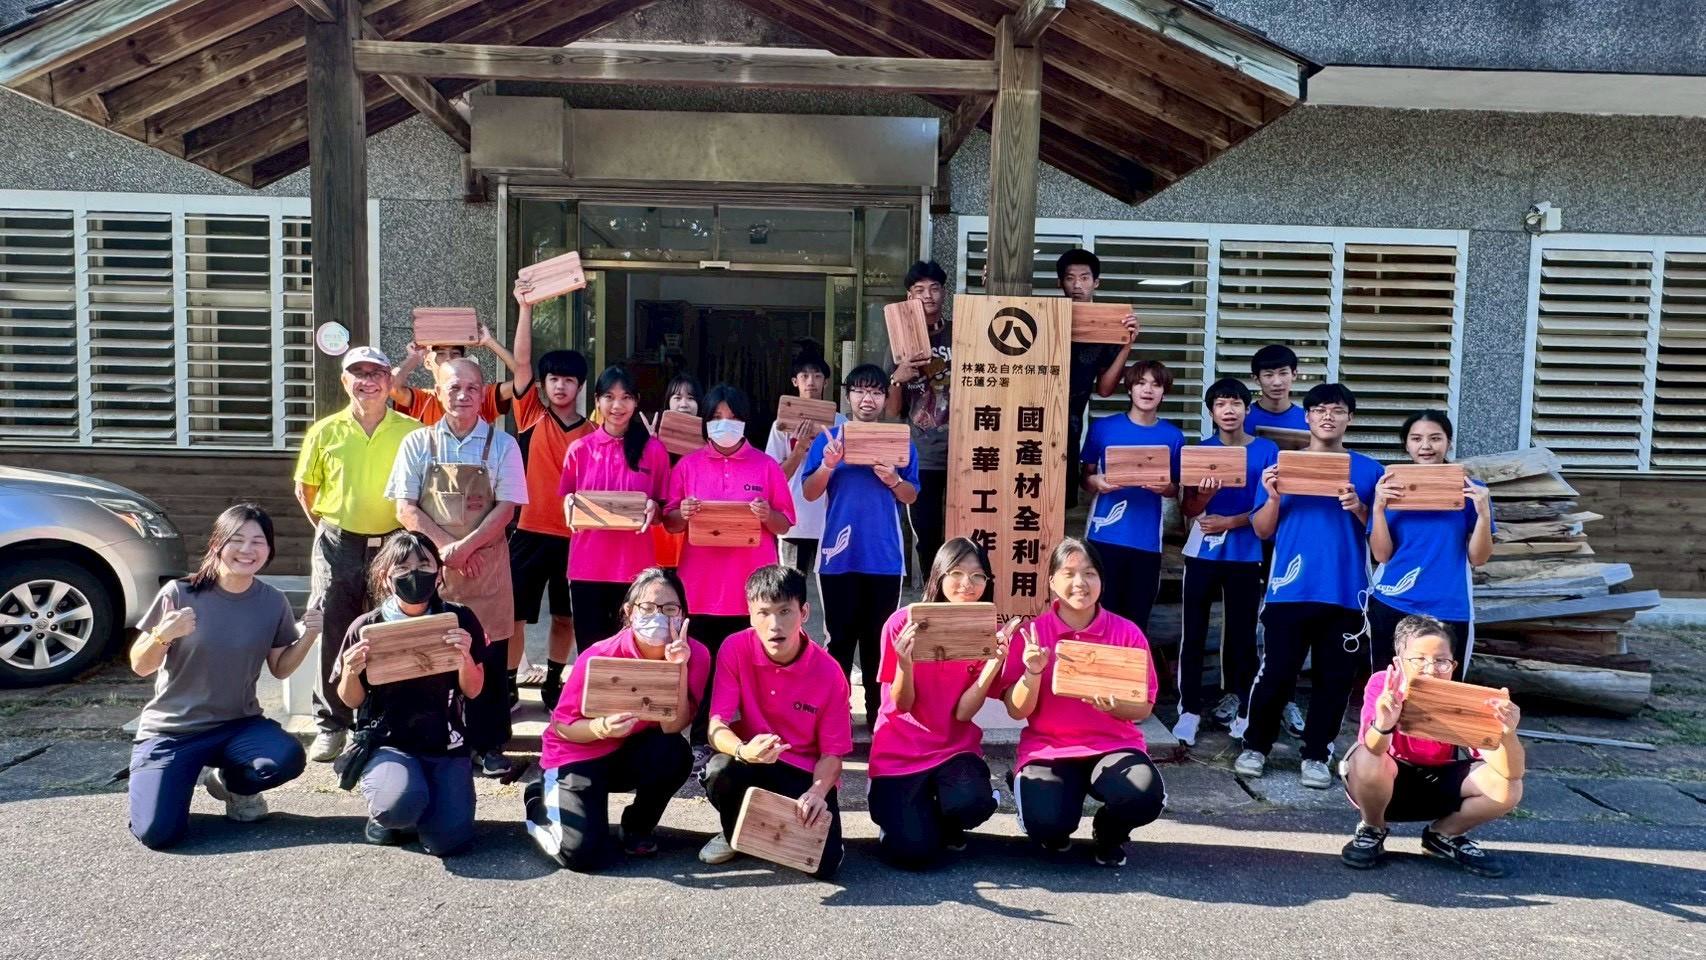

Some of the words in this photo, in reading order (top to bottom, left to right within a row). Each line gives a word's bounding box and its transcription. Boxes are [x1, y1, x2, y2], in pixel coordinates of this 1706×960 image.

[961, 362, 1061, 376] 林業及自然保育署
[961, 376, 1010, 388] 花蓮分署
[1011, 405, 1045, 598] 國產材全利用
